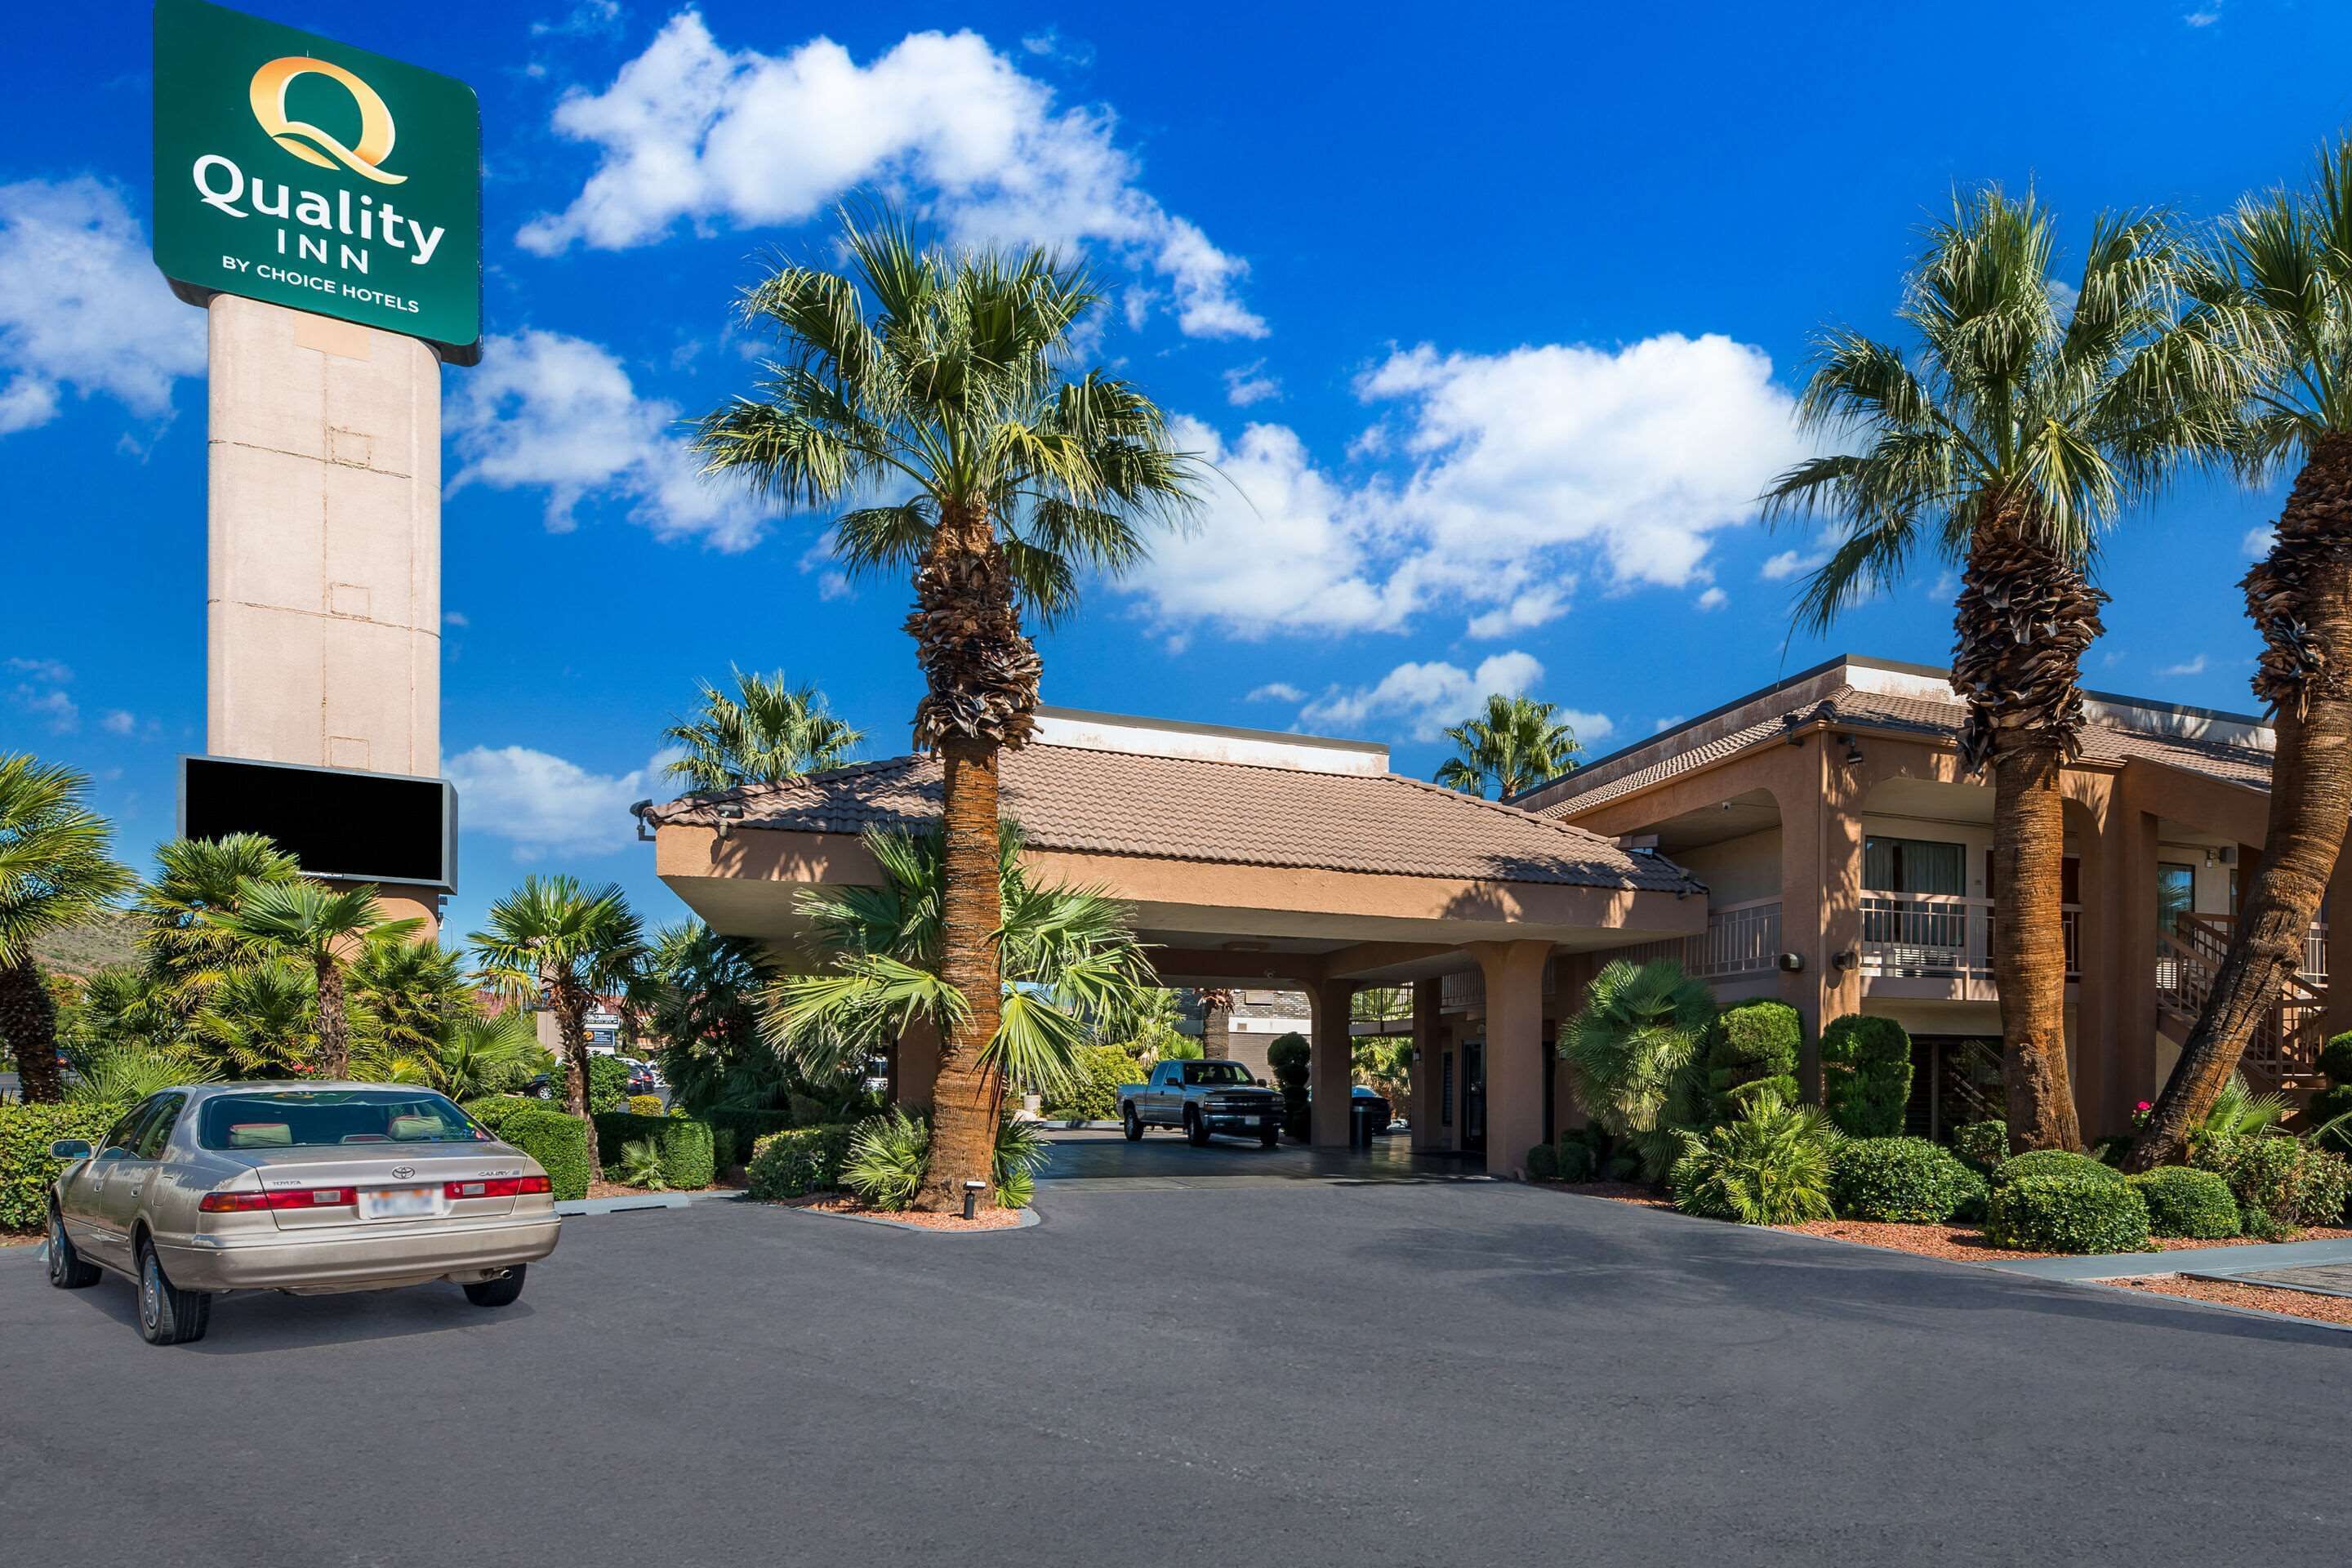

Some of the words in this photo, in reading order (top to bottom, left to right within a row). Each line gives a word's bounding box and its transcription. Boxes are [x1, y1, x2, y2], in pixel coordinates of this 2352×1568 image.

[249, 56, 408, 185] Q
[193, 154, 446, 265] Quality
[278, 228, 368, 274] INN
[222, 256, 250, 273] BY
[256, 265, 336, 294] CHOICE
[342, 283, 419, 314] HOTELS
